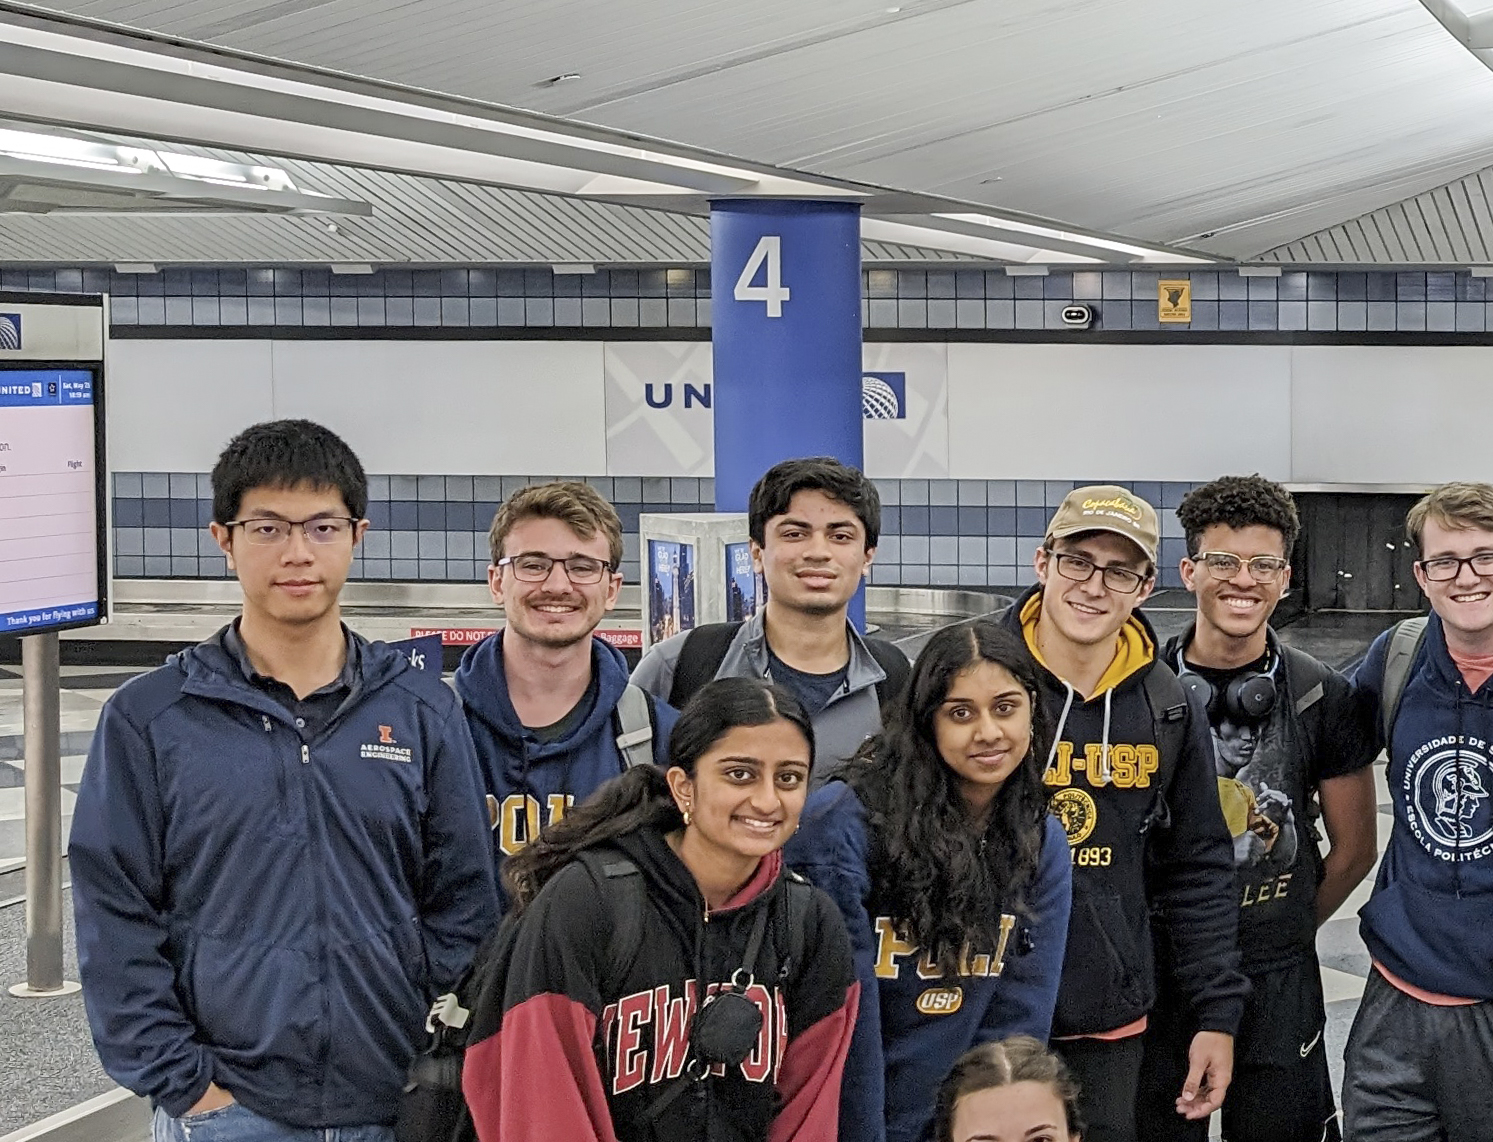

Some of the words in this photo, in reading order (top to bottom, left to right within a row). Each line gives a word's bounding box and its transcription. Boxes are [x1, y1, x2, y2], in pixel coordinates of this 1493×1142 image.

[734, 236, 790, 317] 4
[0, 385, 31, 395] NITED
[67, 460, 83, 469] Flight
[7, 615, 28, 626] Thank
[28, 615, 41, 625] you
[42, 612, 52, 621] for
[53, 609, 71, 622] flying
[72, 607, 86, 617] with
[87, 607, 95, 615] us
[450, 631, 464, 640] DO
[466, 631, 485, 640] NOT
[361, 744, 412, 756] AEROSPACE
[361, 751, 412, 763] ENGINEERING
[1403, 735, 1465, 791] UNIVERSIDADE
[1469, 737, 1487, 750] DE
[1405, 805, 1432, 853] ESCOLA
[1070, 847, 1112, 866] 1893
[1241, 873, 1293, 907] LEE
[920, 990, 959, 1011] USP
